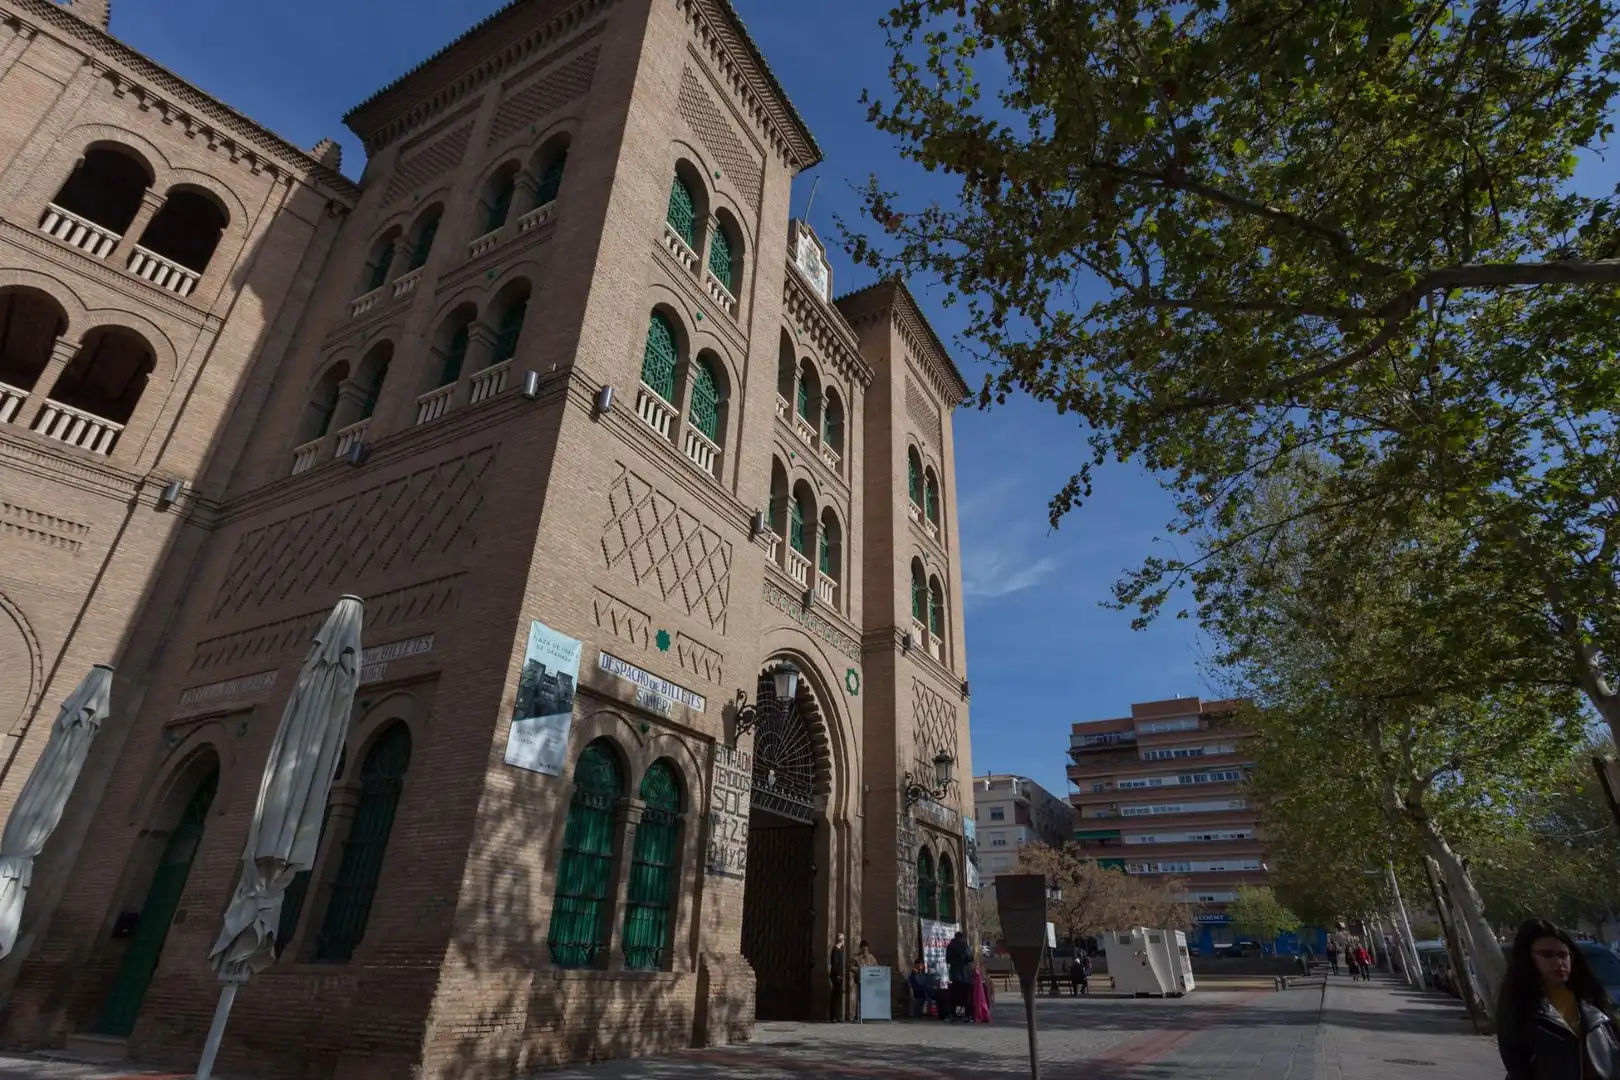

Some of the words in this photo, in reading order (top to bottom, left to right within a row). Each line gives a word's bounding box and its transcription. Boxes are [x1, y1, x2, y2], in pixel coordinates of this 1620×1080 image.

[601, 654, 649, 687] DESPACHO
[649, 680, 660, 691] DE
[661, 680, 701, 710] BILLETES
[636, 689, 671, 715] SOMBRA
[714, 742, 752, 773] ENTRADA
[712, 785, 749, 818] SOL
